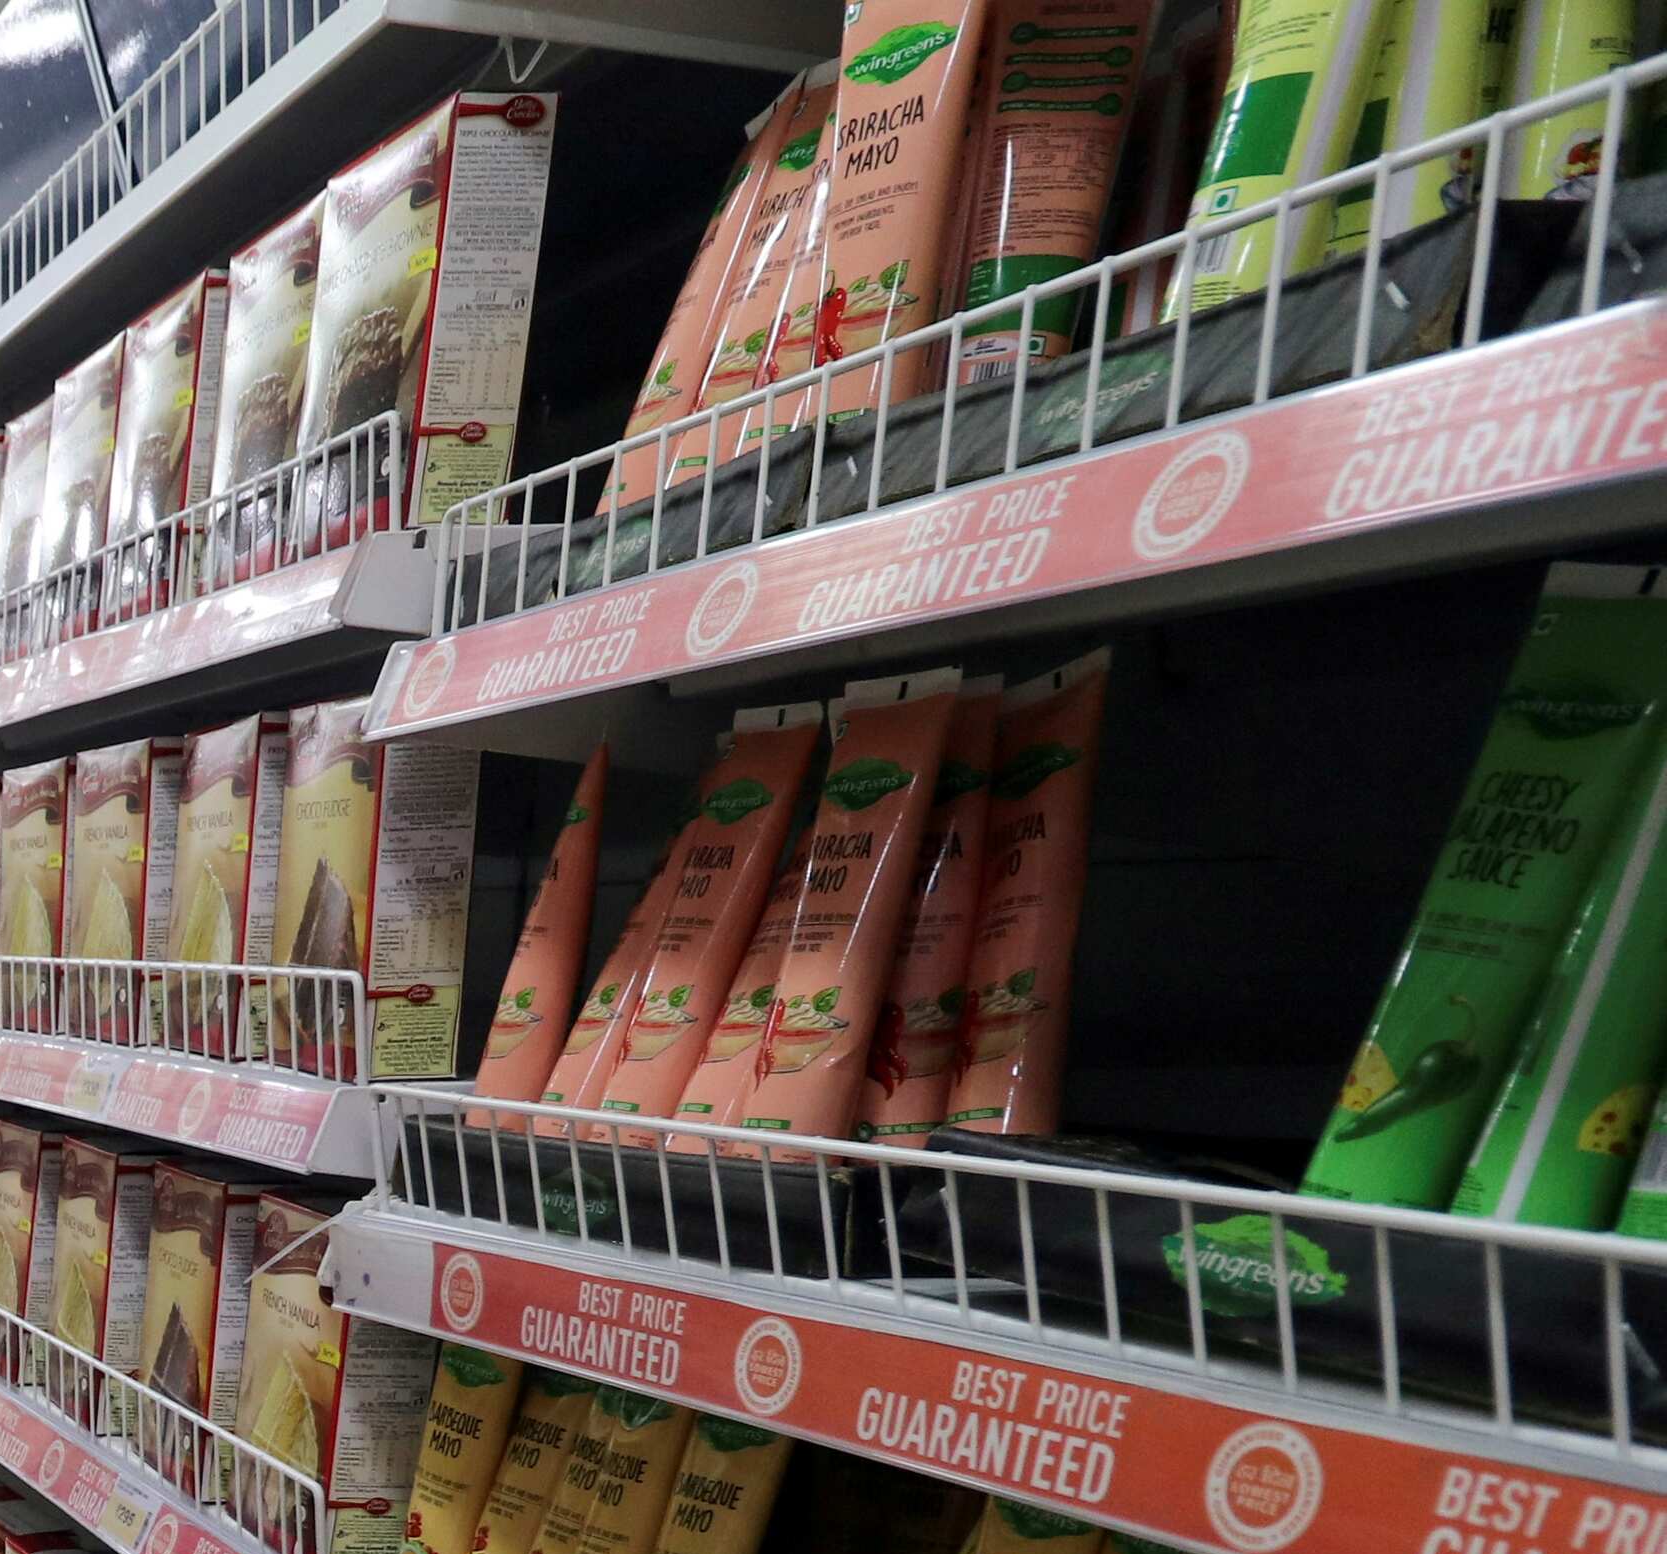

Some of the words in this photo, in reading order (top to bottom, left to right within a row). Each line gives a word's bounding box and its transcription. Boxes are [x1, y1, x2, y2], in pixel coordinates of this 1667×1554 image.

[854, 30, 946, 77] wingreens
[838, 94, 924, 151] SRIRACHA
[844, 137, 899, 180] MAYO
[1324, 379, 1667, 519] GUARANTE
[796, 527, 1051, 634] GUARANTEED
[475, 627, 638, 701] GUARANTEED
[296, 797, 325, 821] CHOCO
[325, 797, 354, 819] FUDGE
[1477, 769, 1581, 817] CHEESY
[209, 807, 235, 830] VANILLA
[803, 862, 849, 896] MAYO
[1446, 849, 1535, 890] SAUCE
[629, 1292, 686, 1337] PRICE
[519, 1306, 682, 1388] GUARANTEED
[951, 1358, 1029, 1415] BEST
[1038, 1375, 1131, 1441] PRICE
[428, 1429, 465, 1461] MAYO
[855, 1386, 1117, 1504] GUARANTEED
[1435, 1466, 1562, 1539] BEST
